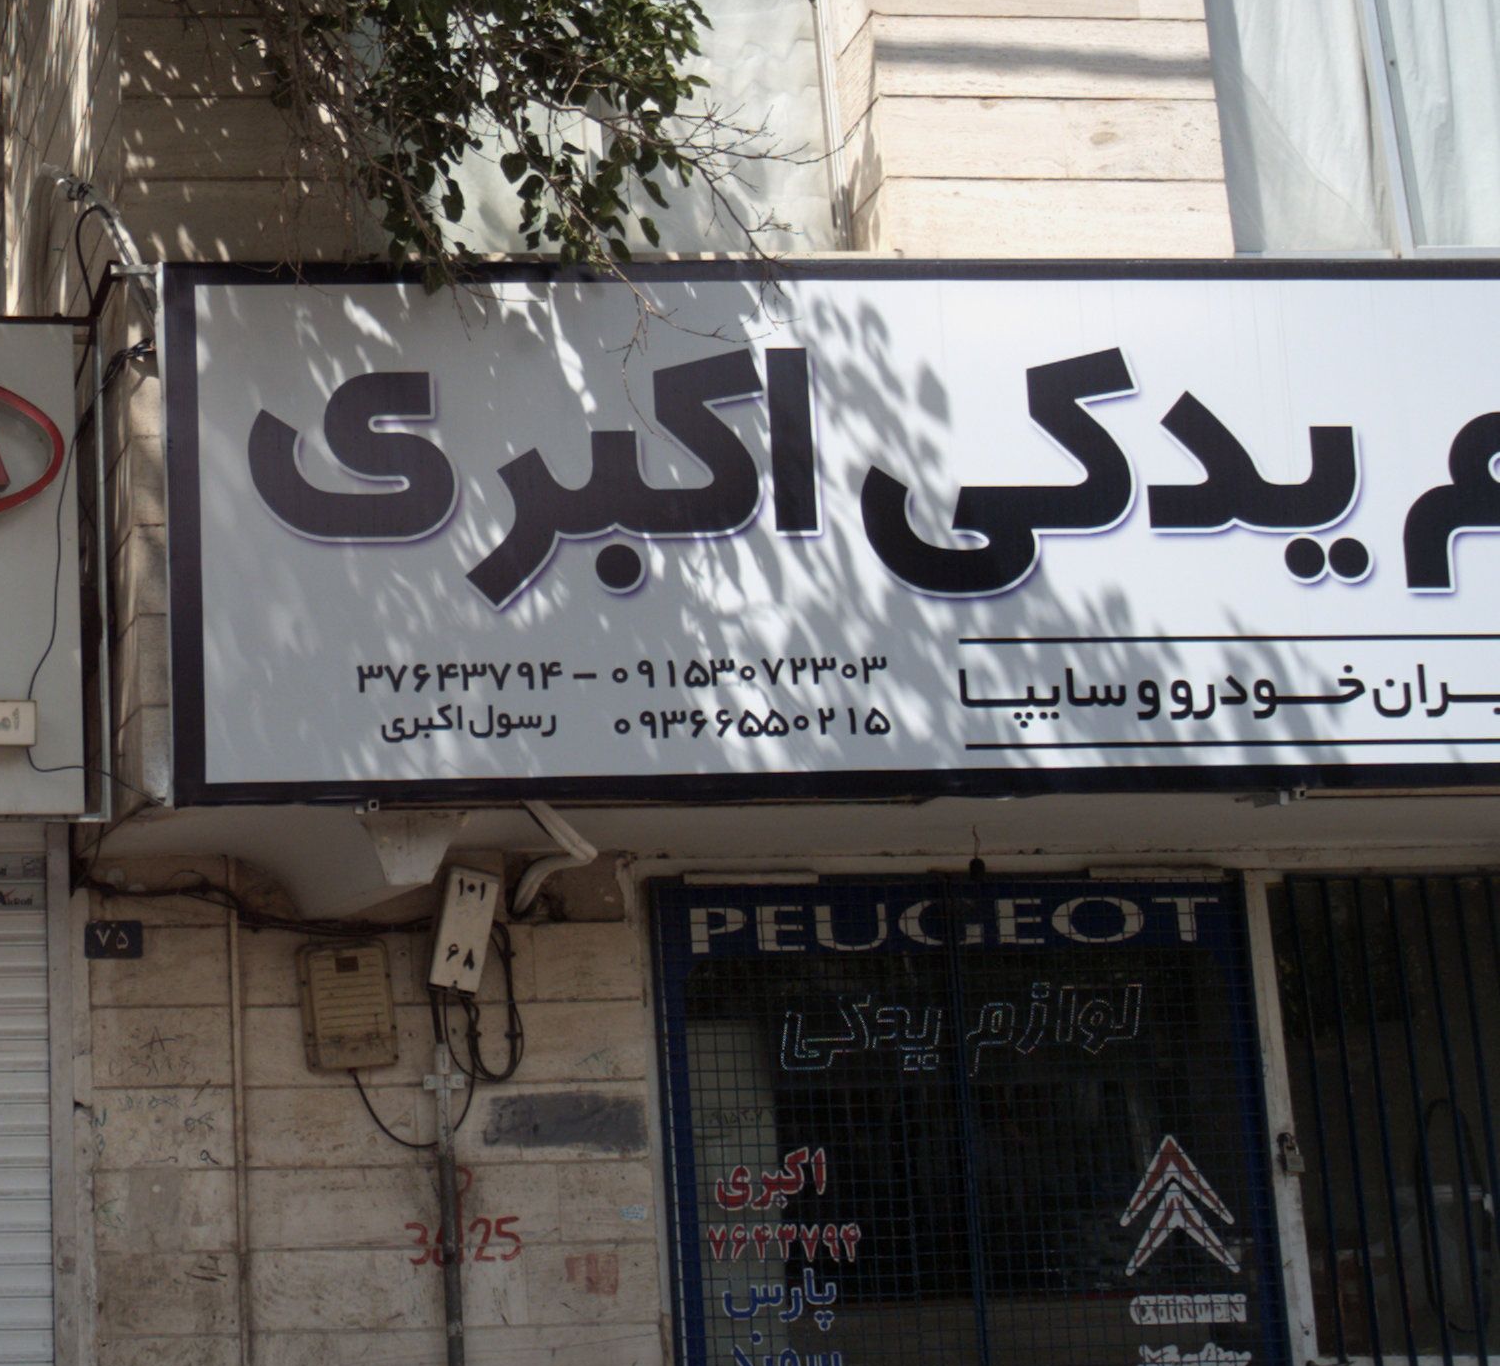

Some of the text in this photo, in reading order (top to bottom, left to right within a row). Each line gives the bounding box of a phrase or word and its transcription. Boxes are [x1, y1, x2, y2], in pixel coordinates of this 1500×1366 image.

[248, 347, 819, 610] اکبری
[861, 346, 1370, 594] یدکی
[357, 661, 563, 694] ۳۷۶۴۳۷۹۴
[611, 656, 888, 690] ۰۹۱۵۳۰۷۲۳۰۳
[958, 668, 1128, 727] سایپا
[1372, 665, 1500, 719] ران
[381, 703, 558, 743] رسول اکبری
[613, 708, 892, 738] ۰۹۳۶۶۵۵۰۲۱۵
[95, 928, 129, 950] ۷۵
[688, 896, 1219, 954] PEUGEOT
[780, 982, 1143, 1077] لوازم یدکی
[715, 1146, 827, 1211] اکبری
[707, 1223, 862, 1263] ۷۶۴۳۷۹۴
[722, 1267, 837, 1331] پارس
